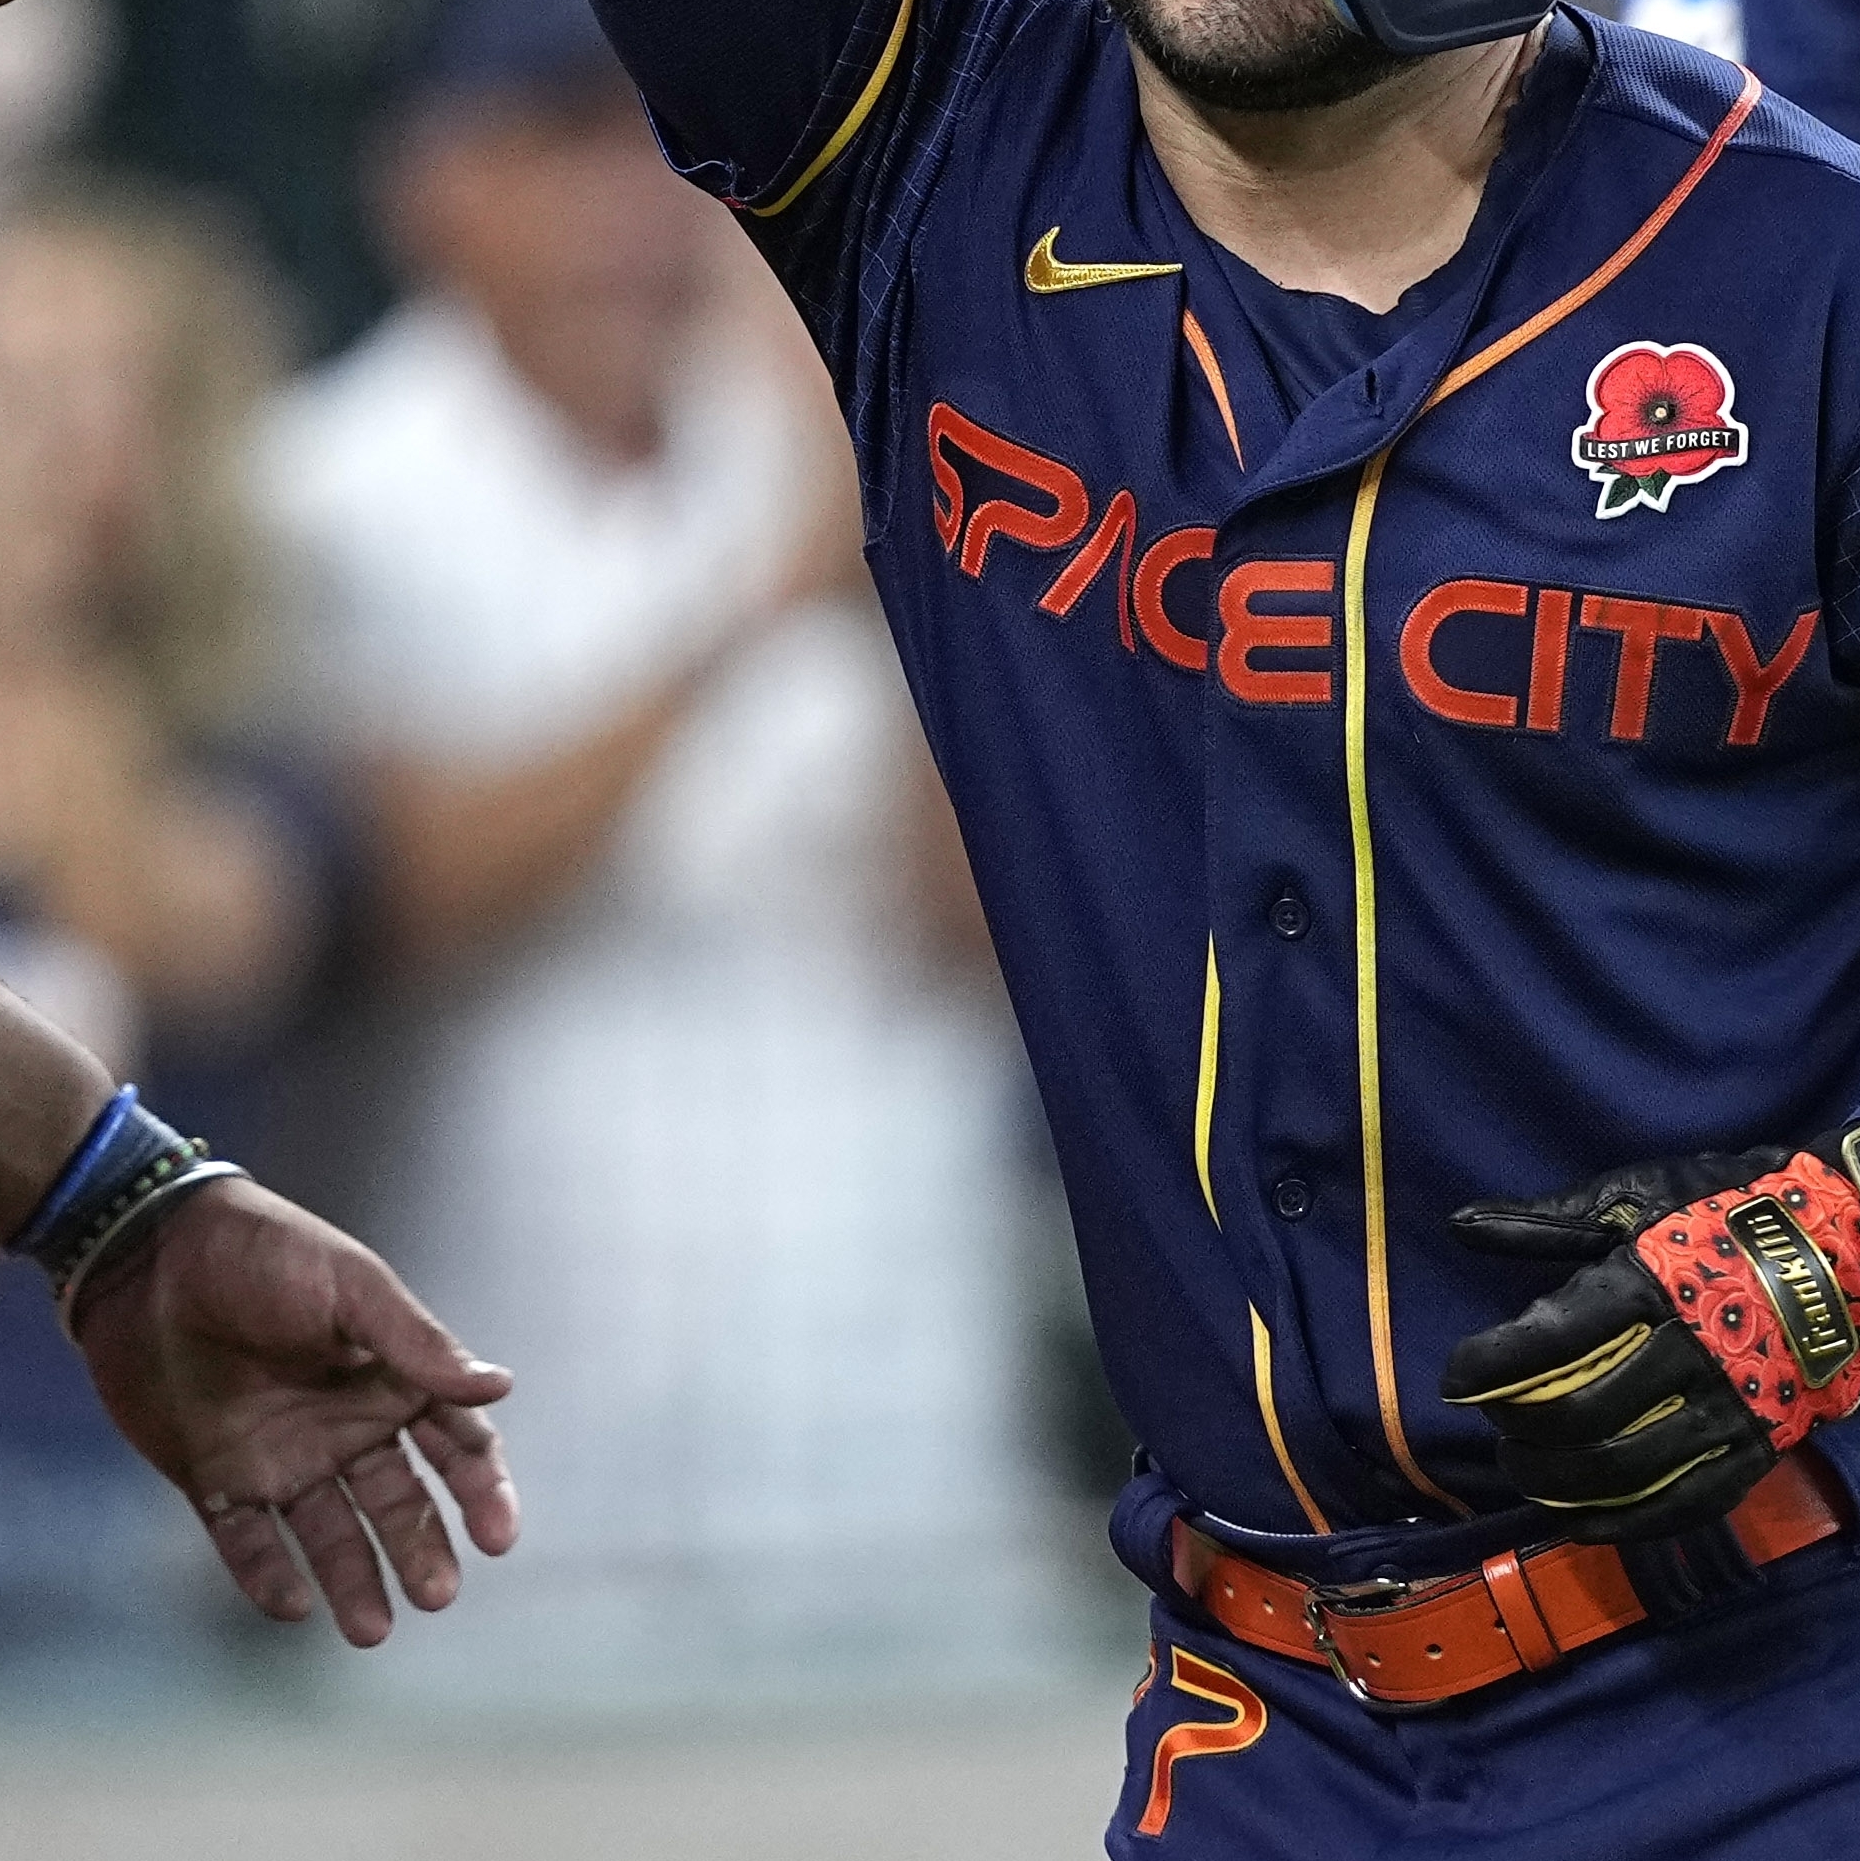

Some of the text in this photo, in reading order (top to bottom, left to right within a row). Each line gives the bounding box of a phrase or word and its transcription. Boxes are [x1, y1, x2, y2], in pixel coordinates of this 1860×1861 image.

[1587, 431, 1732, 460] LEST WE FORGET
[928, 401, 1821, 746] SPACE CITY
